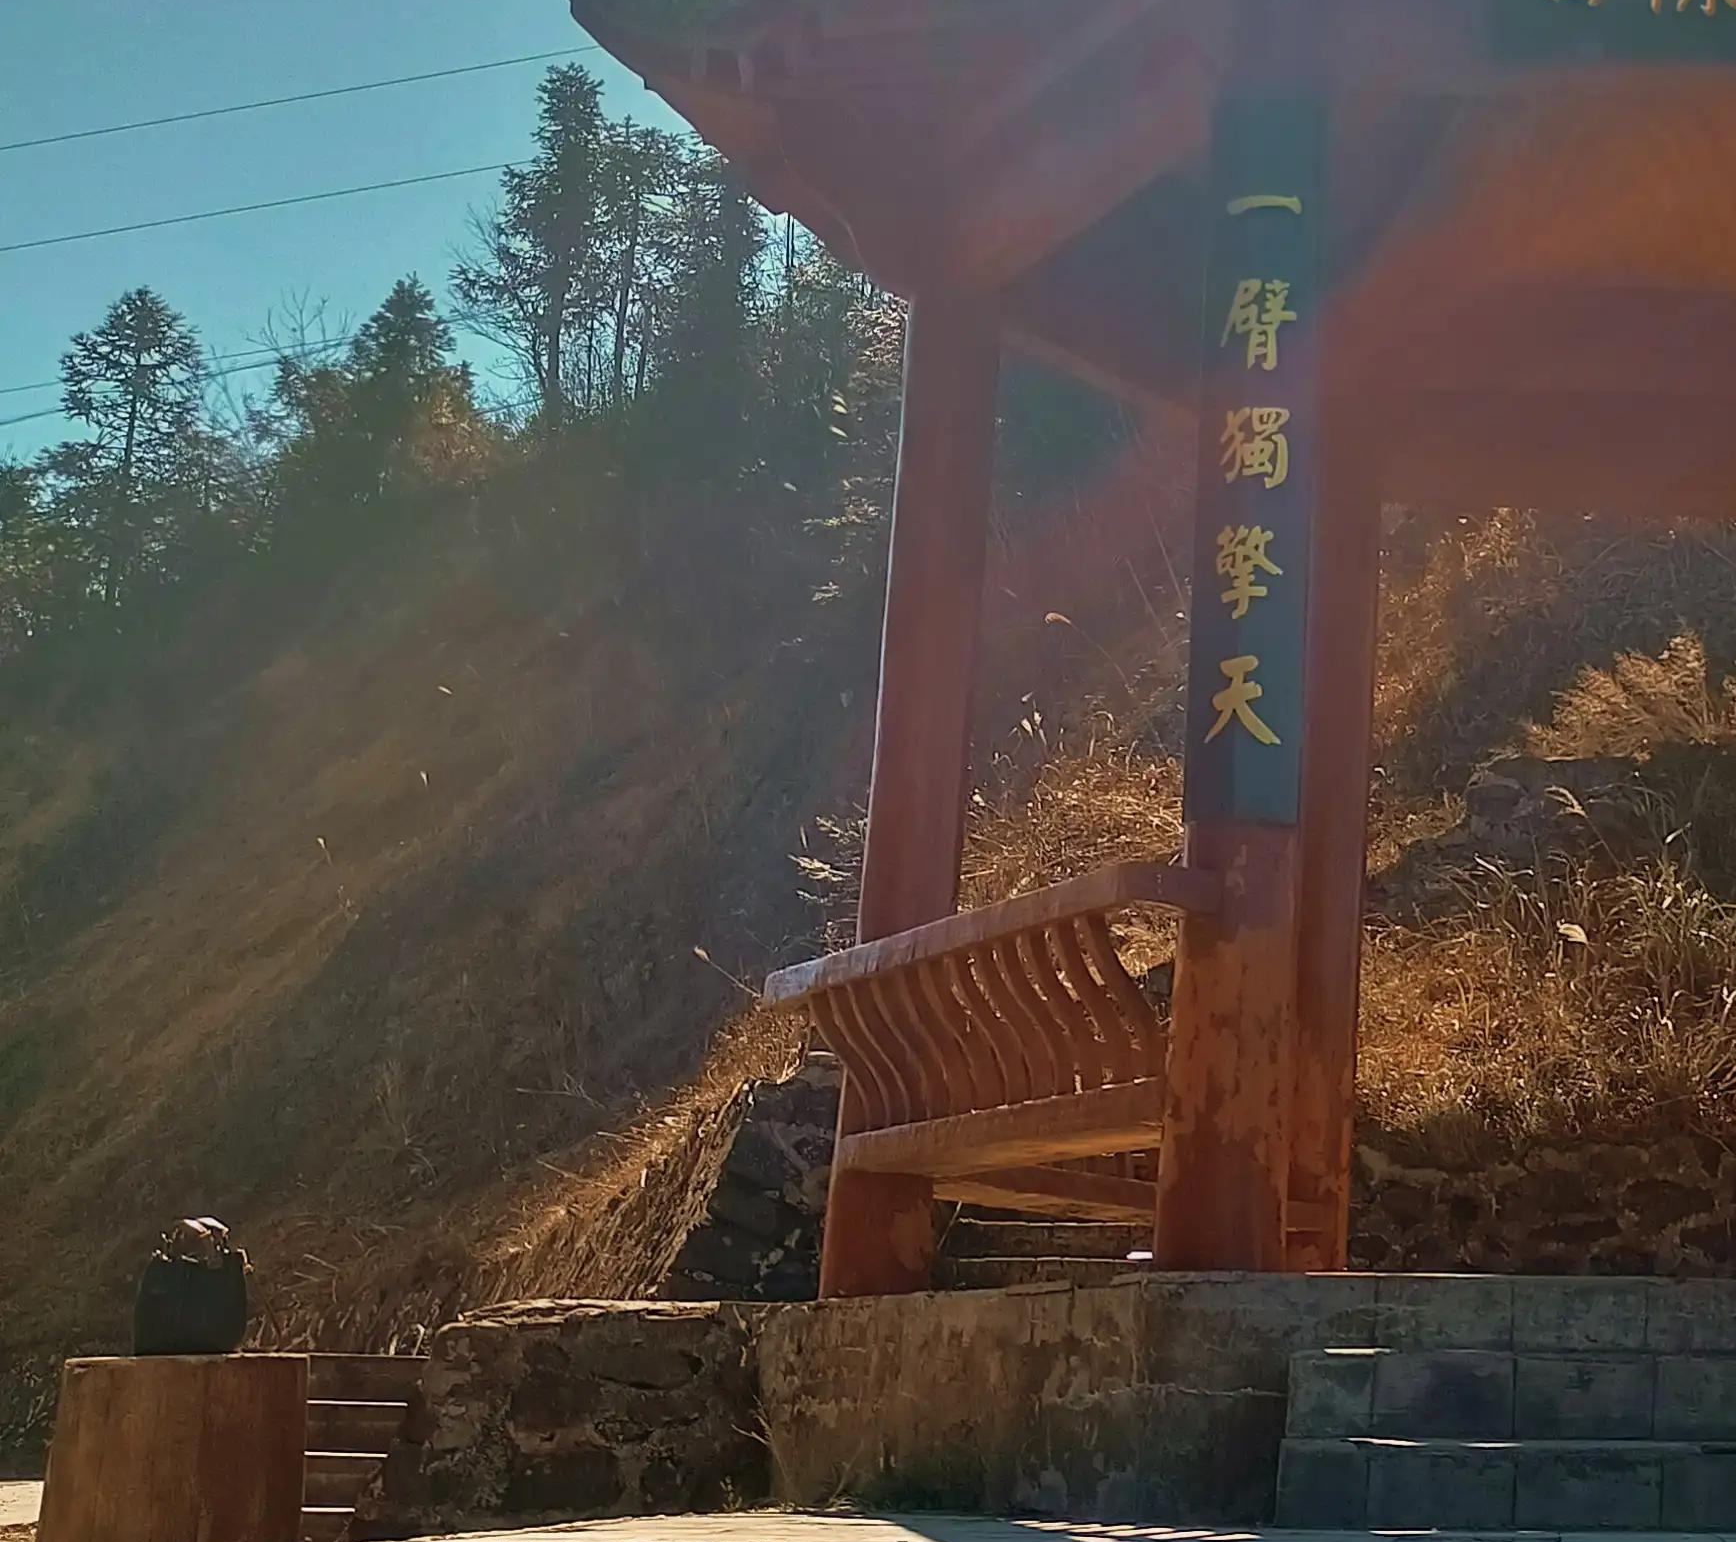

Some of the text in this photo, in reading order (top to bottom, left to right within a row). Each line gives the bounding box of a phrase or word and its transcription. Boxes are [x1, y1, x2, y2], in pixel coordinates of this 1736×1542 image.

[1204, 193, 1302, 747] 一臂獨擎天
